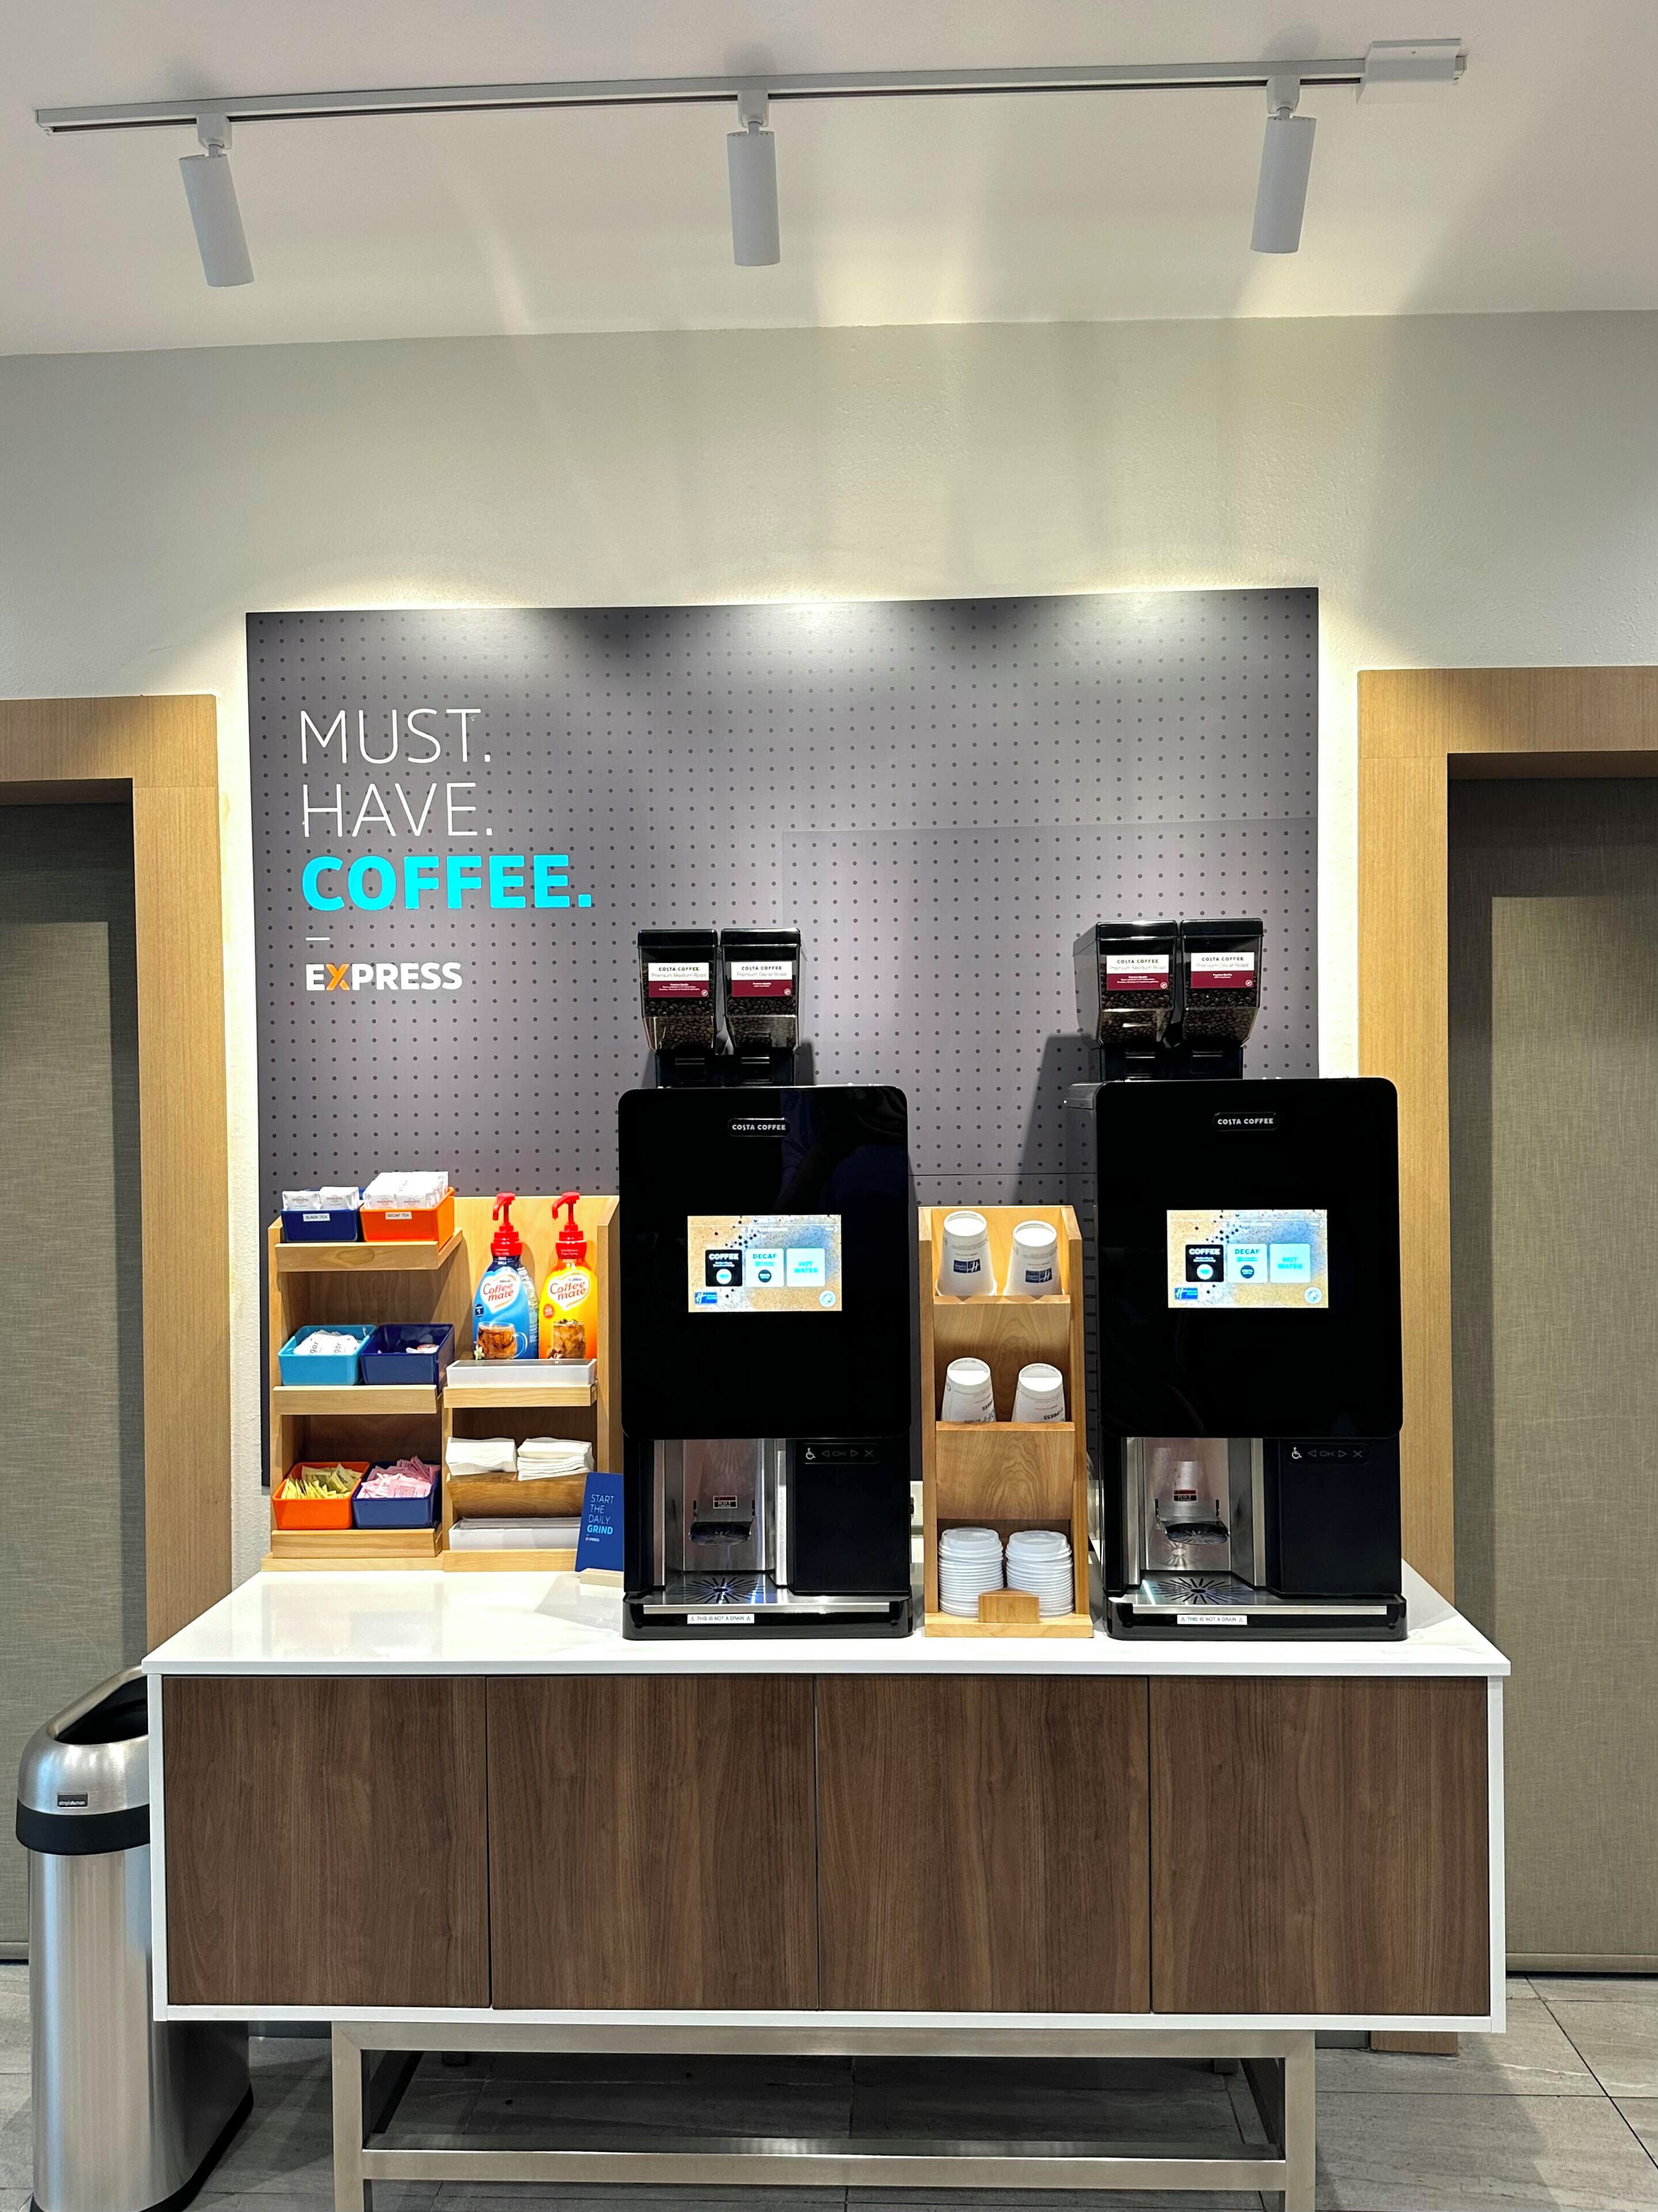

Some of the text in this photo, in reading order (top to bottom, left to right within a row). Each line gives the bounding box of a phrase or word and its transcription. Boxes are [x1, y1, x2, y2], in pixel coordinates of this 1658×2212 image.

[300, 707, 491, 764] MUST.
[303, 782, 493, 838] HAVE.
[301, 854, 592, 911] COFFEE.
[306, 962, 462, 991] EXPRESS
[483, 1283, 513, 1295] Coffee
[549, 1282, 585, 1295] Coffee
[557, 1288, 586, 1301] mate
[488, 1290, 514, 1302] mate
[590, 1494, 614, 1504] START
[590, 1504, 605, 1514] THE
[588, 1514, 611, 1524] DAILY
[587, 1524, 613, 1535] GRIND
